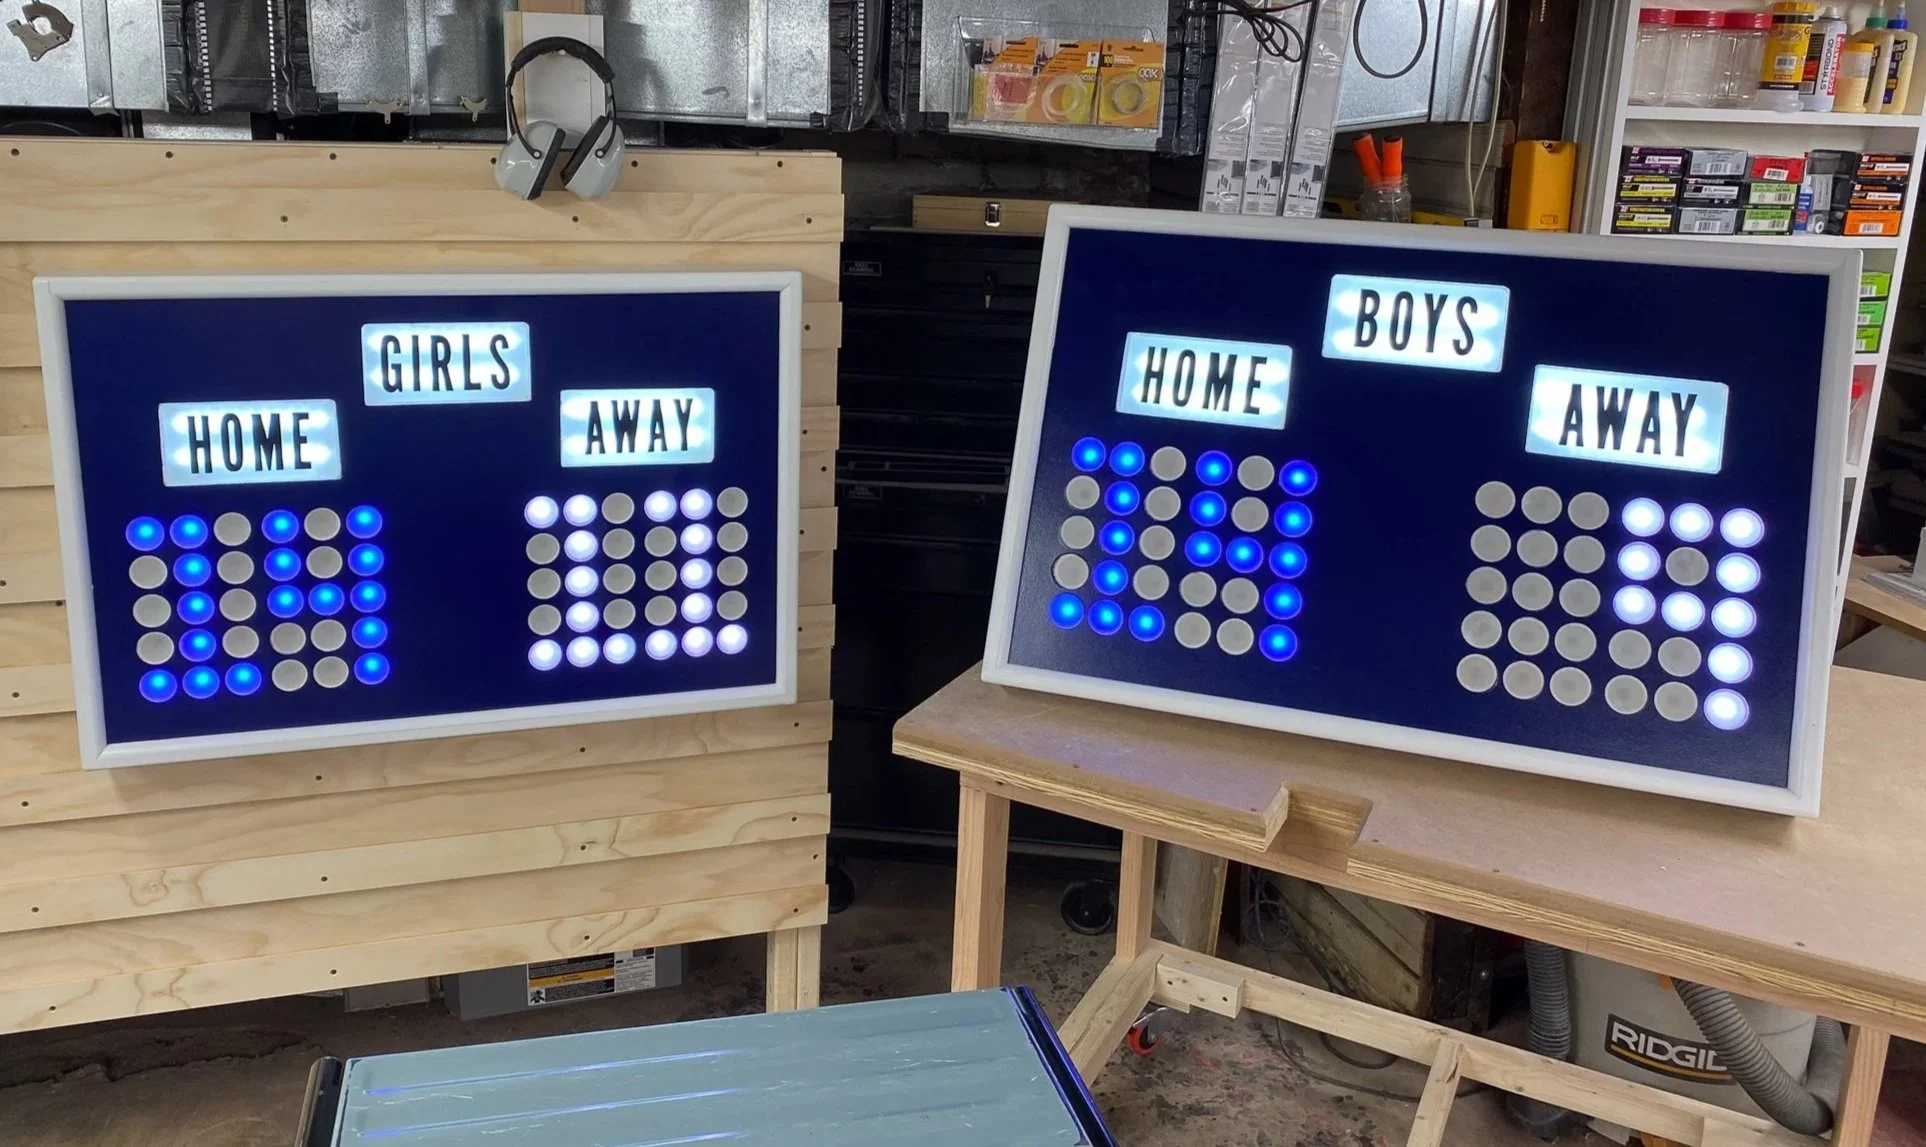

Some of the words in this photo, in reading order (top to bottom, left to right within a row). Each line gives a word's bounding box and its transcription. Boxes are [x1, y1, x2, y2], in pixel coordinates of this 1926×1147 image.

[1138, 67, 1158, 78] OOK
[1355, 288, 1479, 356] BOYS
[380, 334, 511, 393] GIRLS
[1140, 345, 1269, 415] HOME
[187, 412, 312, 474] HOME
[586, 399, 694, 454] AWAY
[1558, 383, 1698, 458] AWAY
[524, 488, 748, 671] 11
[1049, 437, 1317, 662] 14
[125, 505, 390, 702] 14
[1613, 497, 1764, 730] 9
